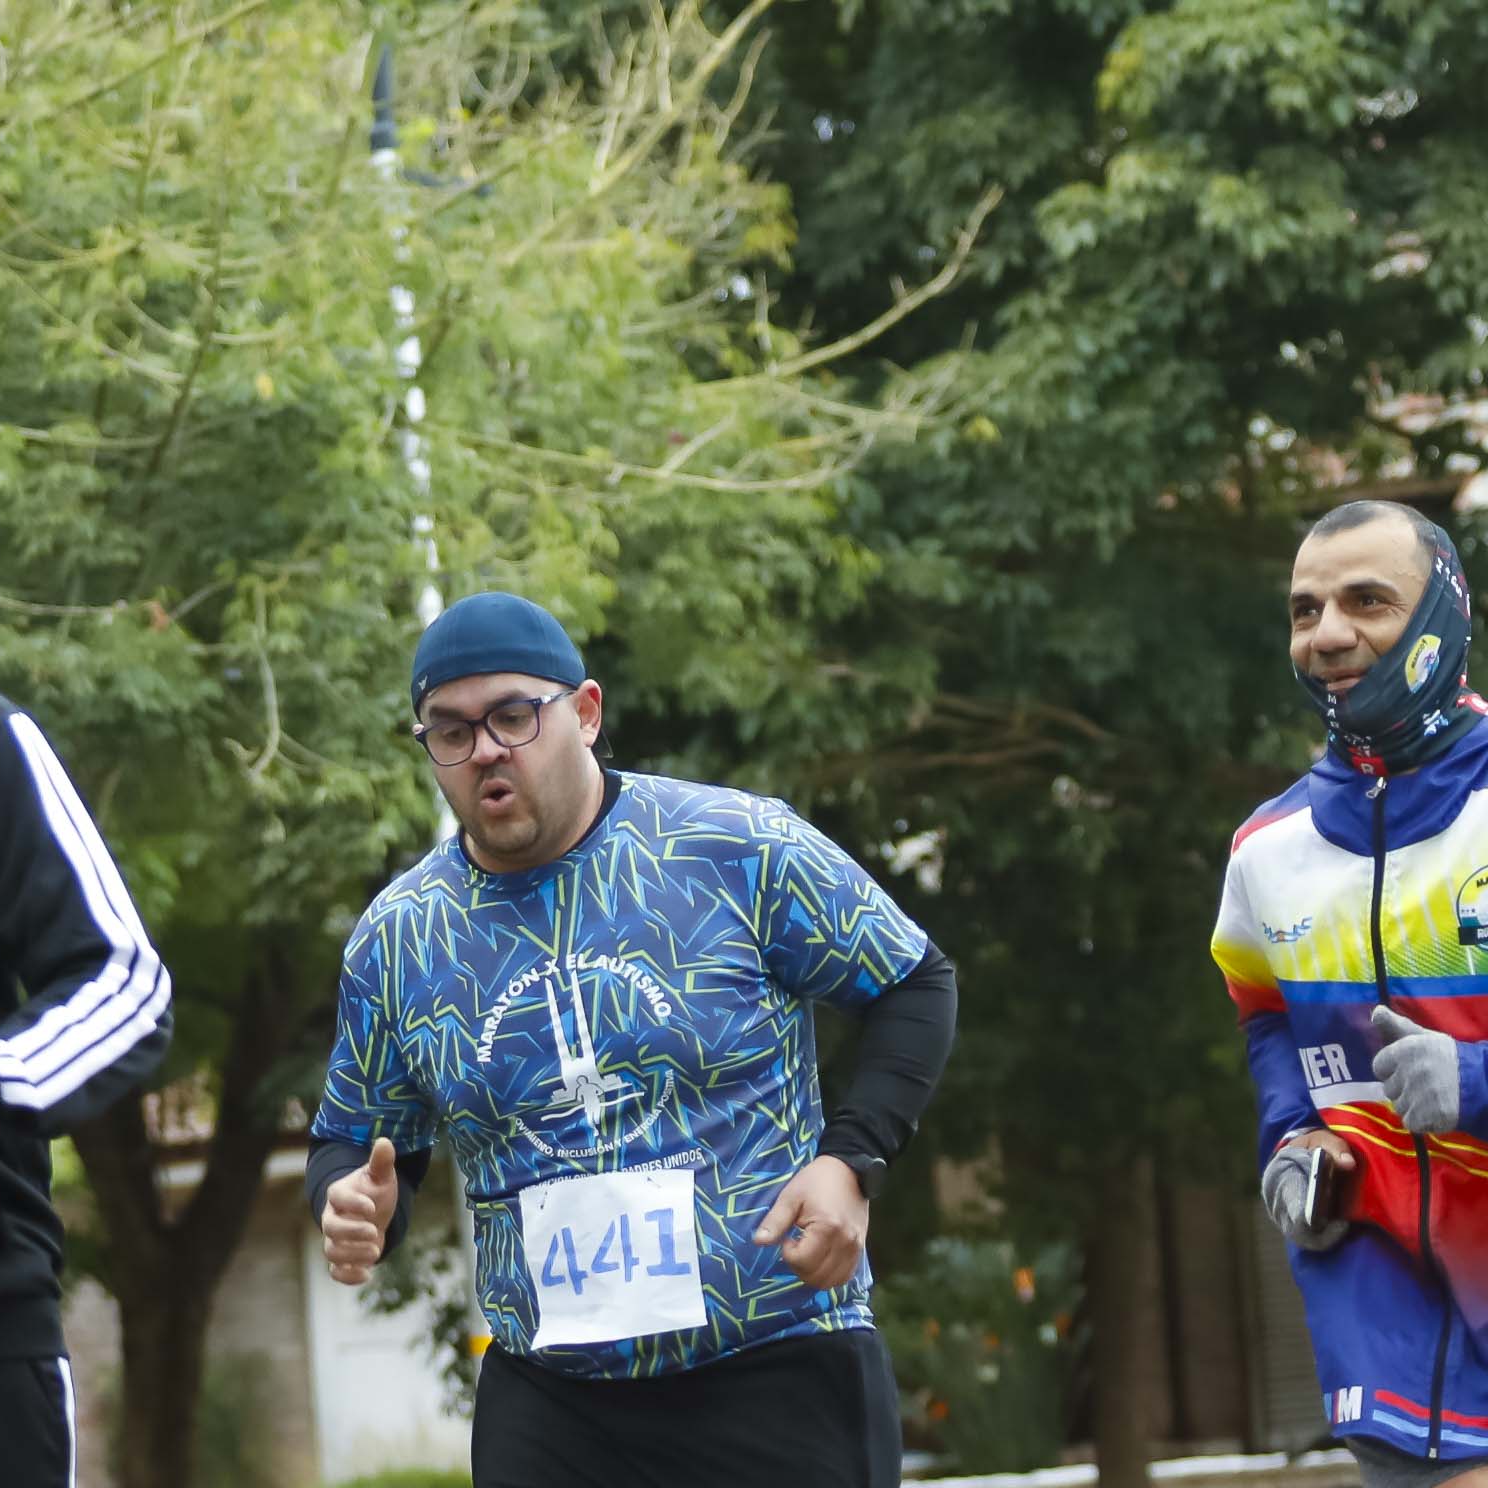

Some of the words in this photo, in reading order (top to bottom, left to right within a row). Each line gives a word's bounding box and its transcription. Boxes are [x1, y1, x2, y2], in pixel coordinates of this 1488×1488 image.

[545, 957, 561, 976] X
[566, 954, 590, 970] EL
[594, 956, 672, 1018] AUTISMO
[663, 1147, 702, 1169] UNIDOS
[542, 1208, 693, 1295] 441
